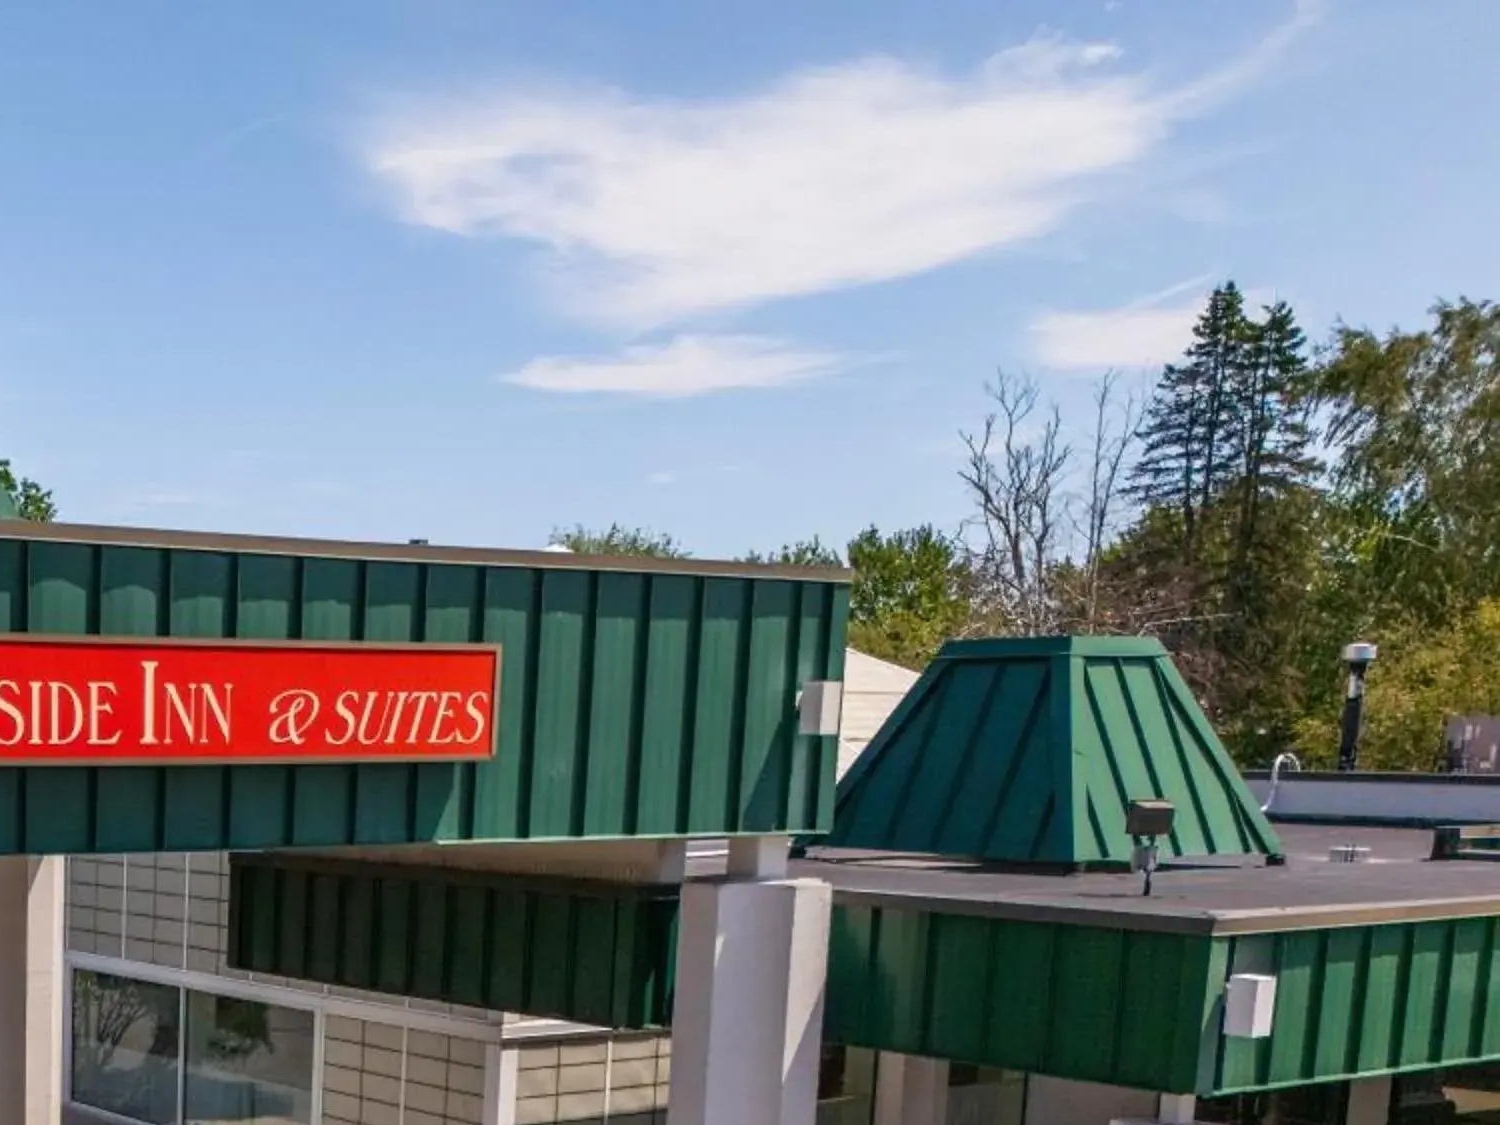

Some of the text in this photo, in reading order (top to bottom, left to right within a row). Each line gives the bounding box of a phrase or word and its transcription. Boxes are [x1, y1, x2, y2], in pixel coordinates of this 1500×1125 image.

[140, 660, 233, 745] INN
[268, 689, 322, 746] &
[325, 690, 489, 746] SUITES
